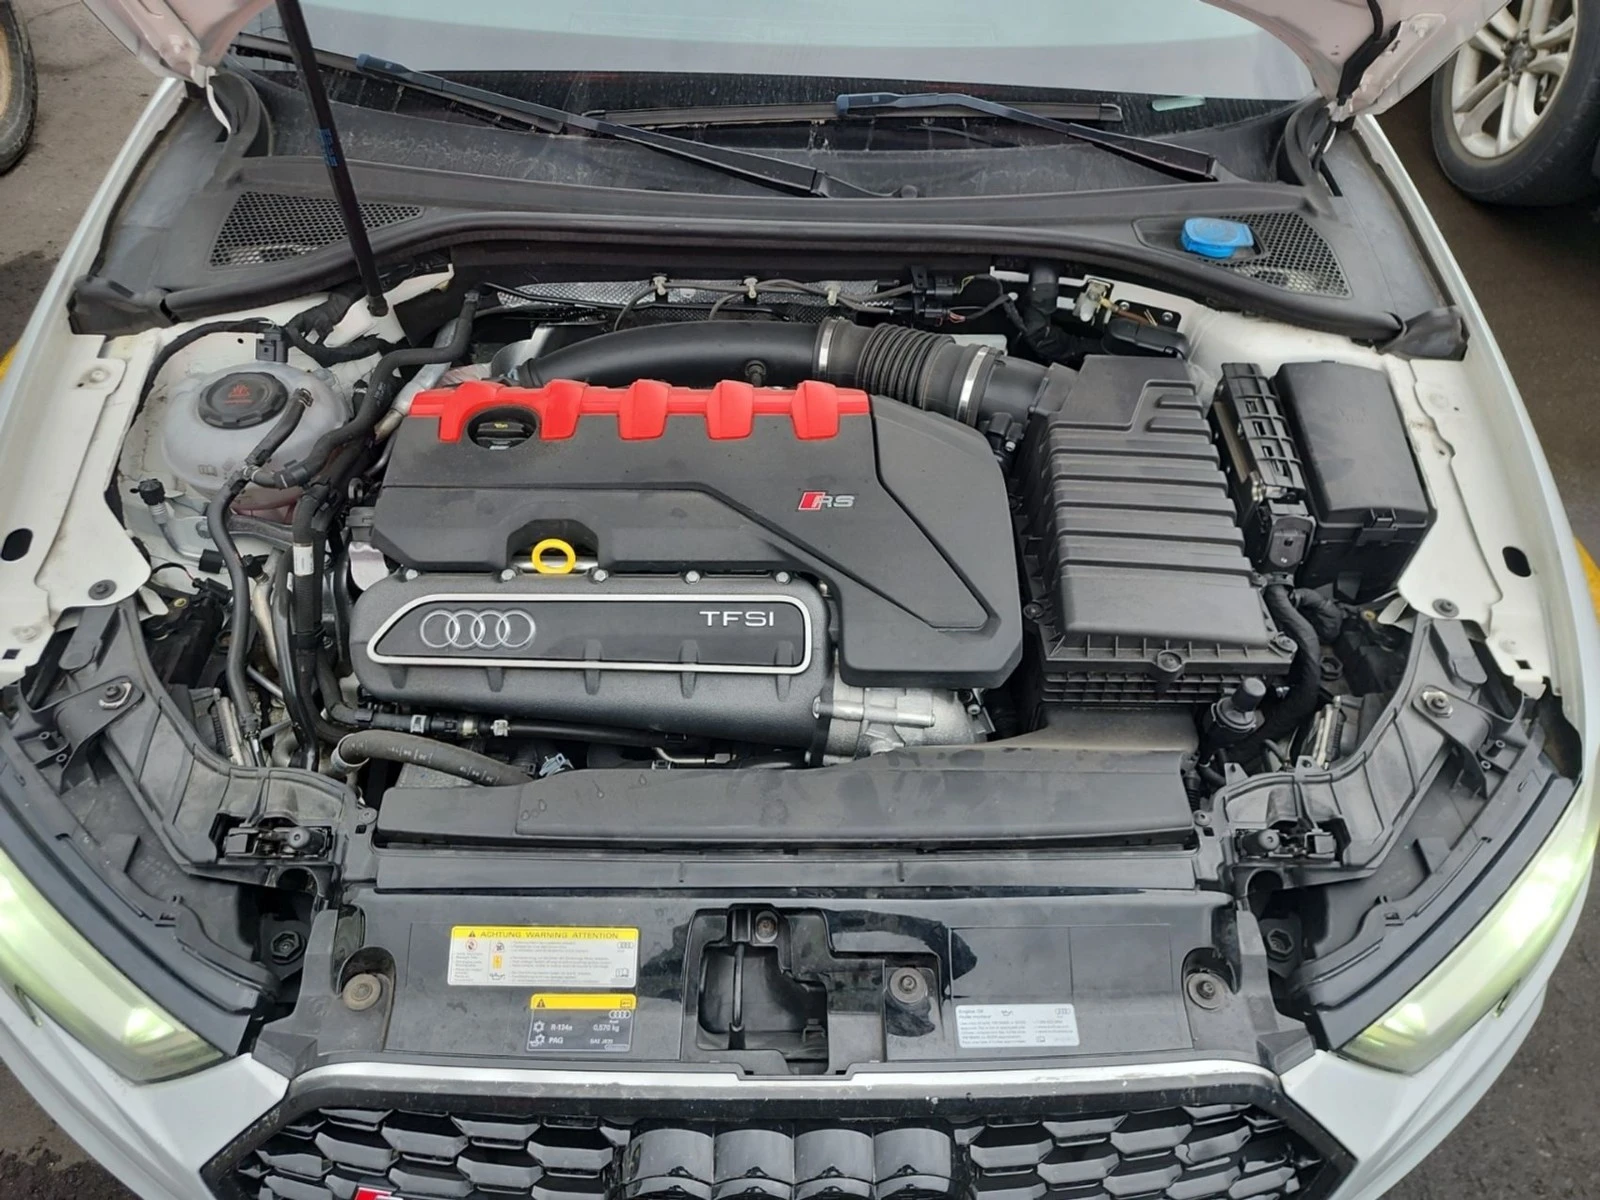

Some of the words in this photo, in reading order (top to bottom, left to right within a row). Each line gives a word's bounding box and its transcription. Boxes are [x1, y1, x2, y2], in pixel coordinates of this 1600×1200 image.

[809, 493, 855, 509] RS
[699, 611, 774, 627] TFSI
[480, 931, 522, 939] ACHTUNG
[525, 931, 568, 940] WARNING
[571, 931, 619, 940] ATTENTION
[550, 1023, 573, 1032] R-134a
[548, 1036, 564, 1045] PAG
